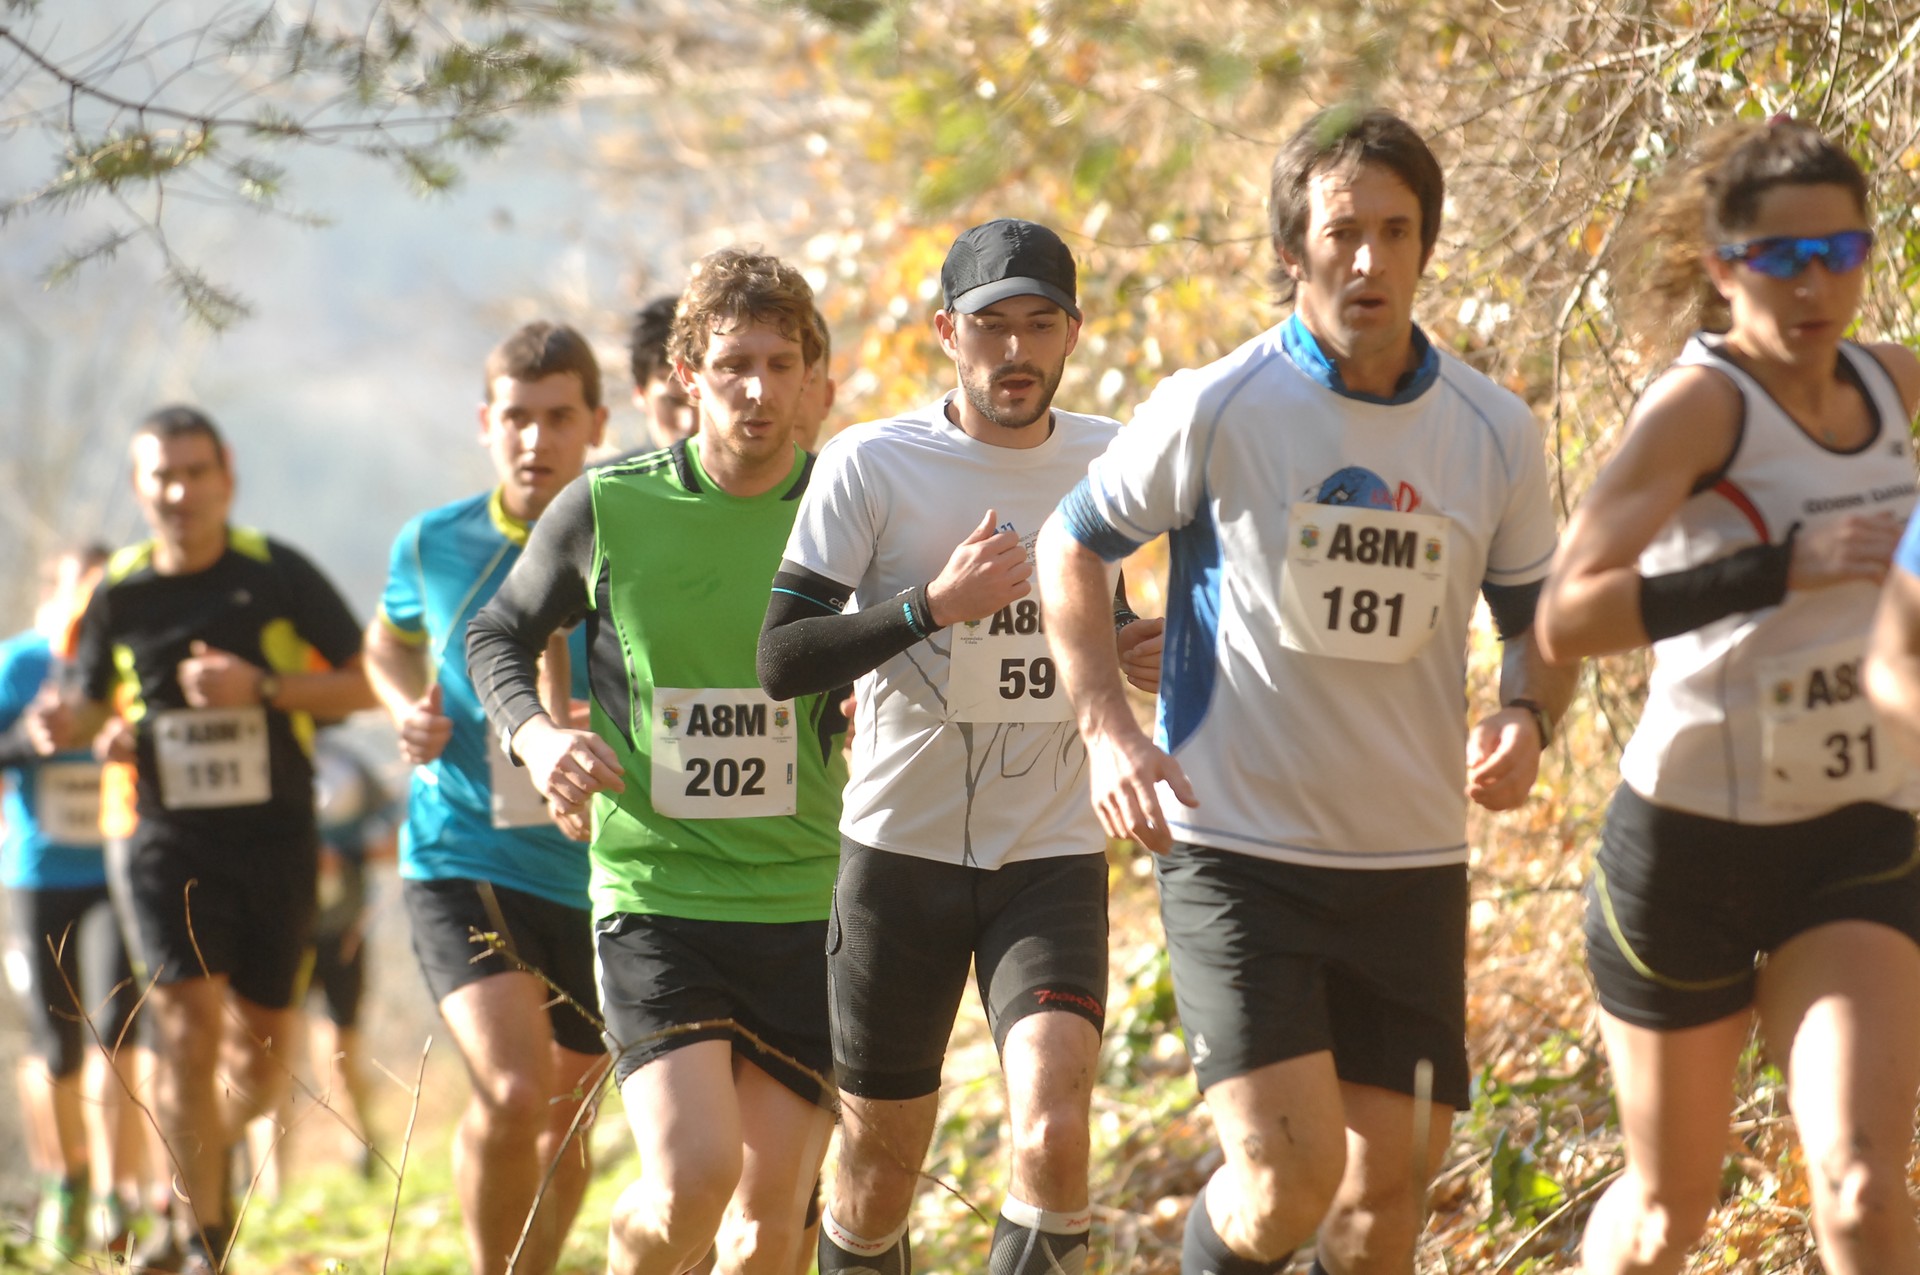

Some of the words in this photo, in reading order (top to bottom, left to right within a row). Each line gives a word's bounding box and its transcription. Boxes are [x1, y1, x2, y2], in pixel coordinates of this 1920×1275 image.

[1326, 523, 1418, 569] A8M
[988, 599, 1045, 636] A8
[1323, 586, 1405, 637] 181
[999, 657, 1056, 700] 59
[686, 703, 767, 738] A8M
[1825, 724, 1876, 779] 31
[685, 757, 766, 797] 202
